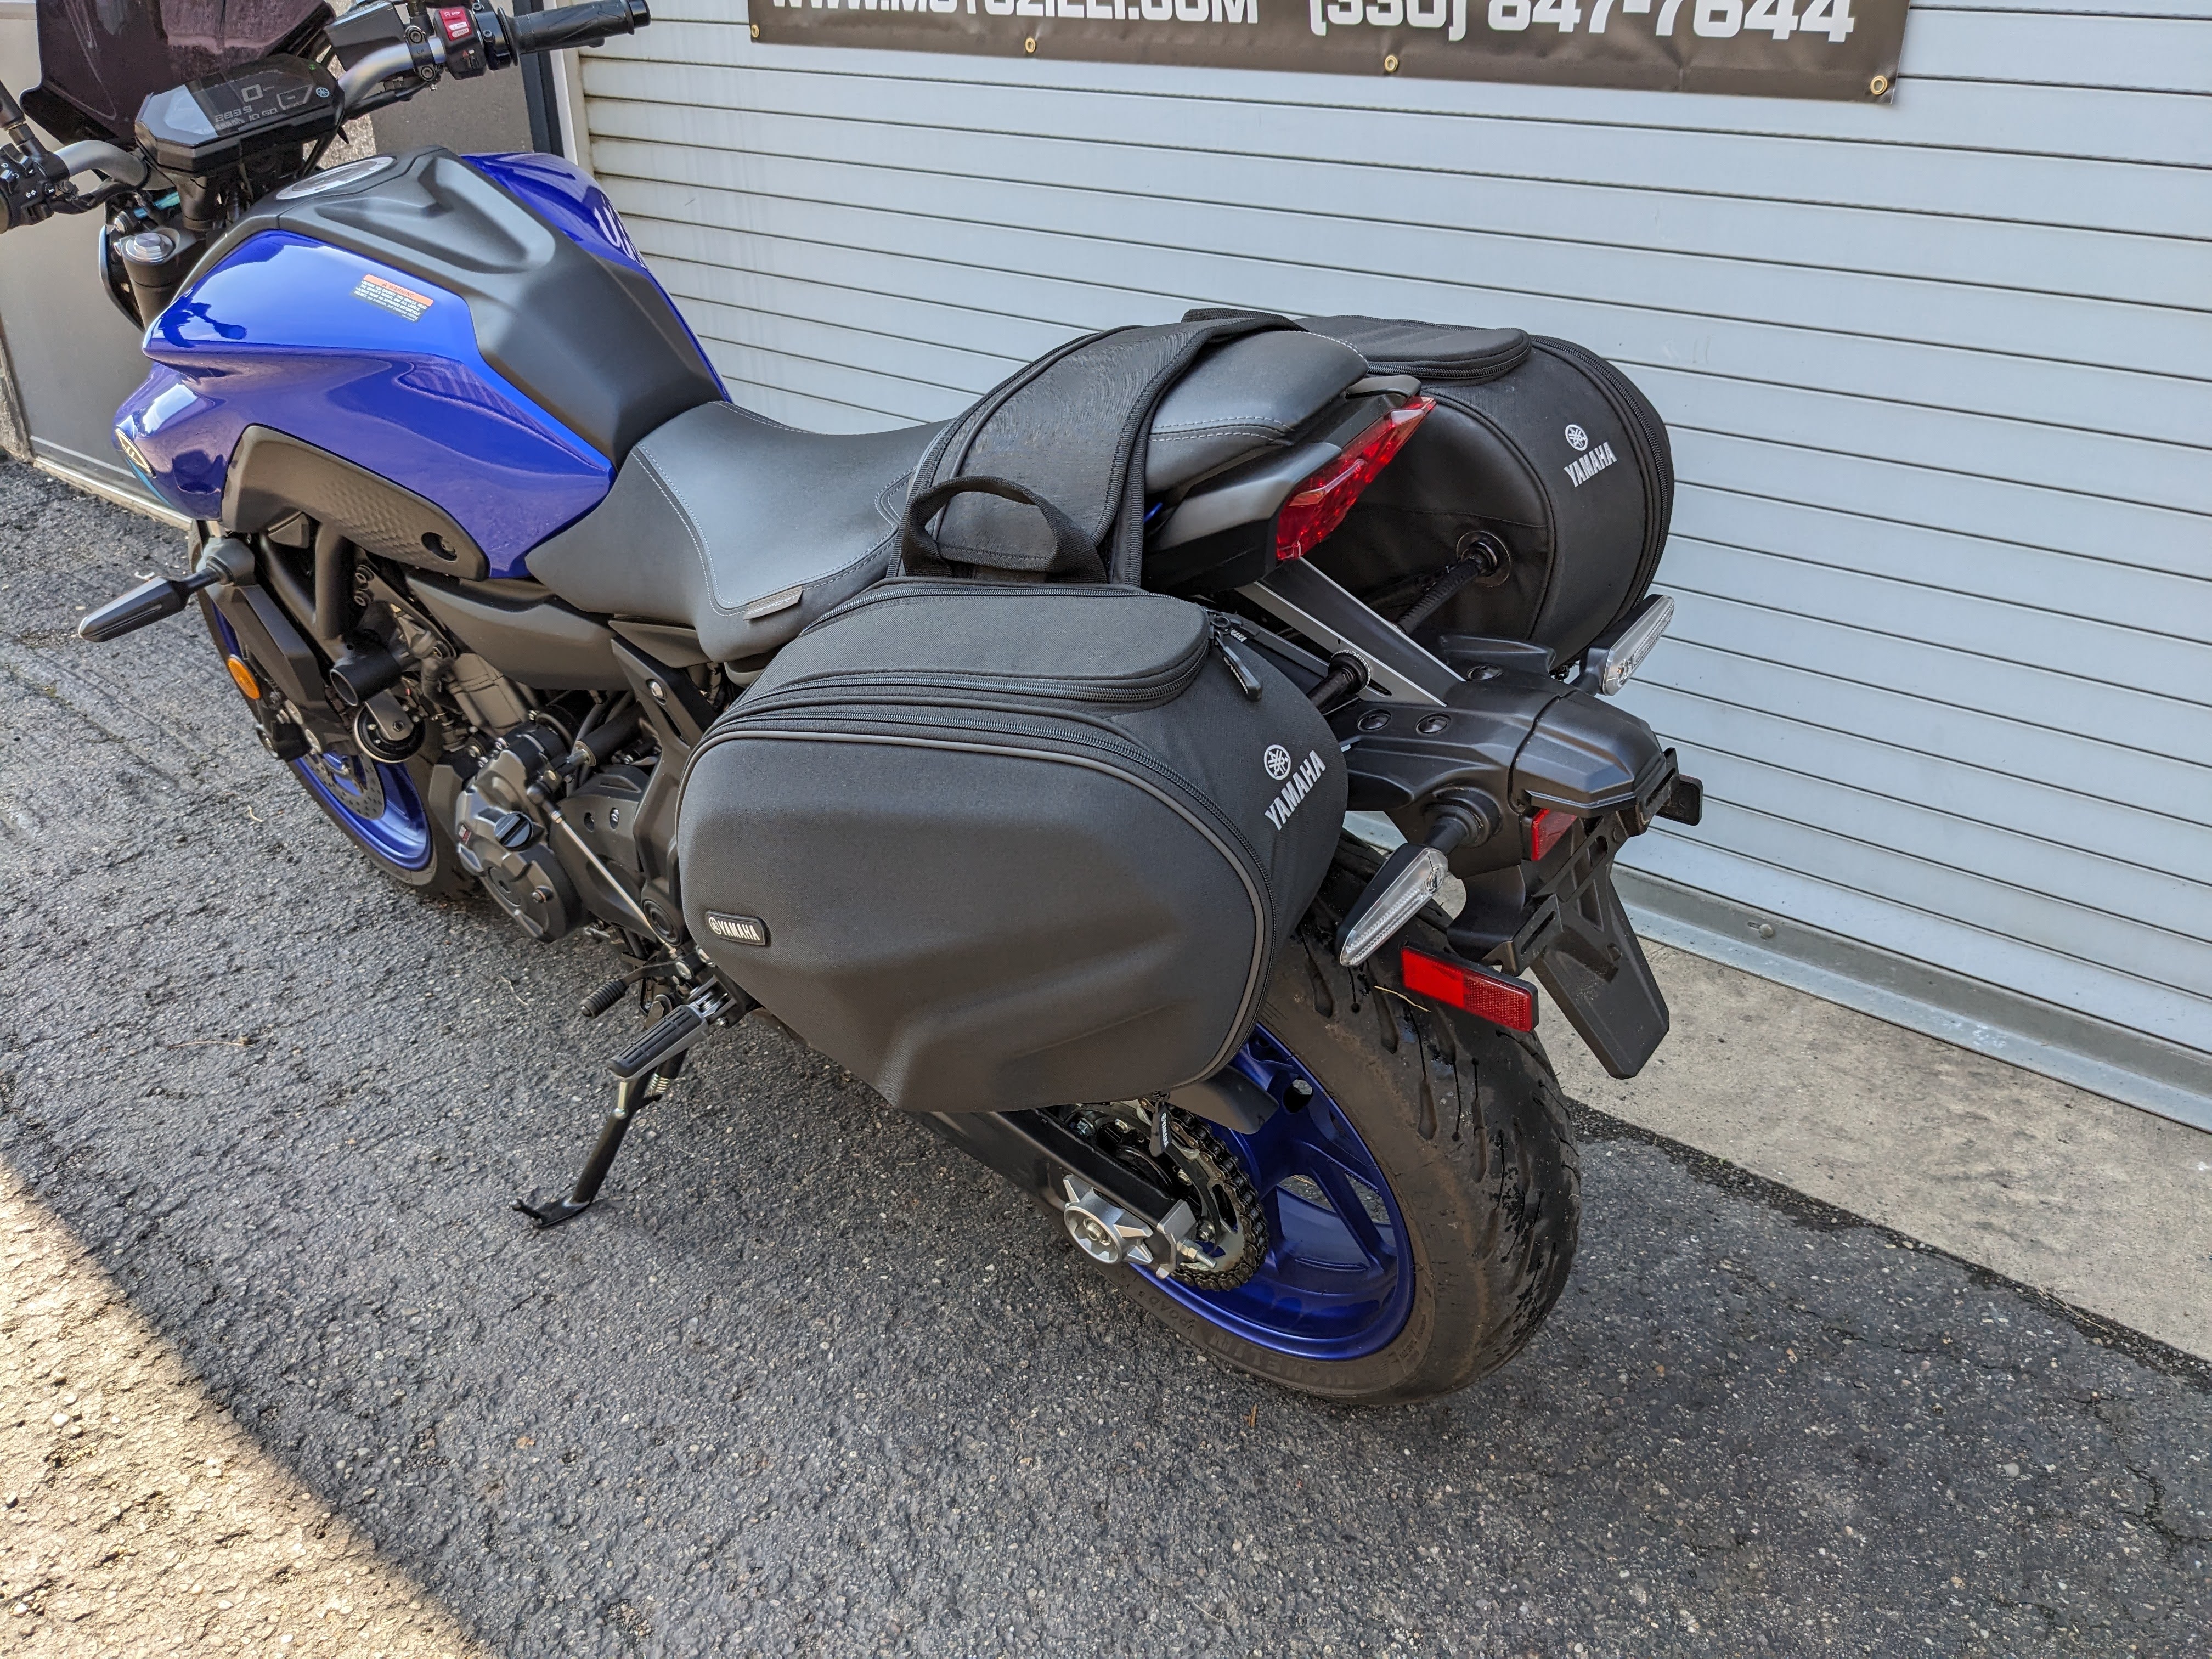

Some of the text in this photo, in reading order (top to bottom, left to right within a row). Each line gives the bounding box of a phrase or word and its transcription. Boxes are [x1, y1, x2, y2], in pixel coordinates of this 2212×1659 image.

[389, 285, 415, 298] WARNING
[1564, 441, 1618, 487] YAMAHA
[1265, 749, 1326, 831] YAMAHA
[717, 920, 761, 941] YAMAHA
